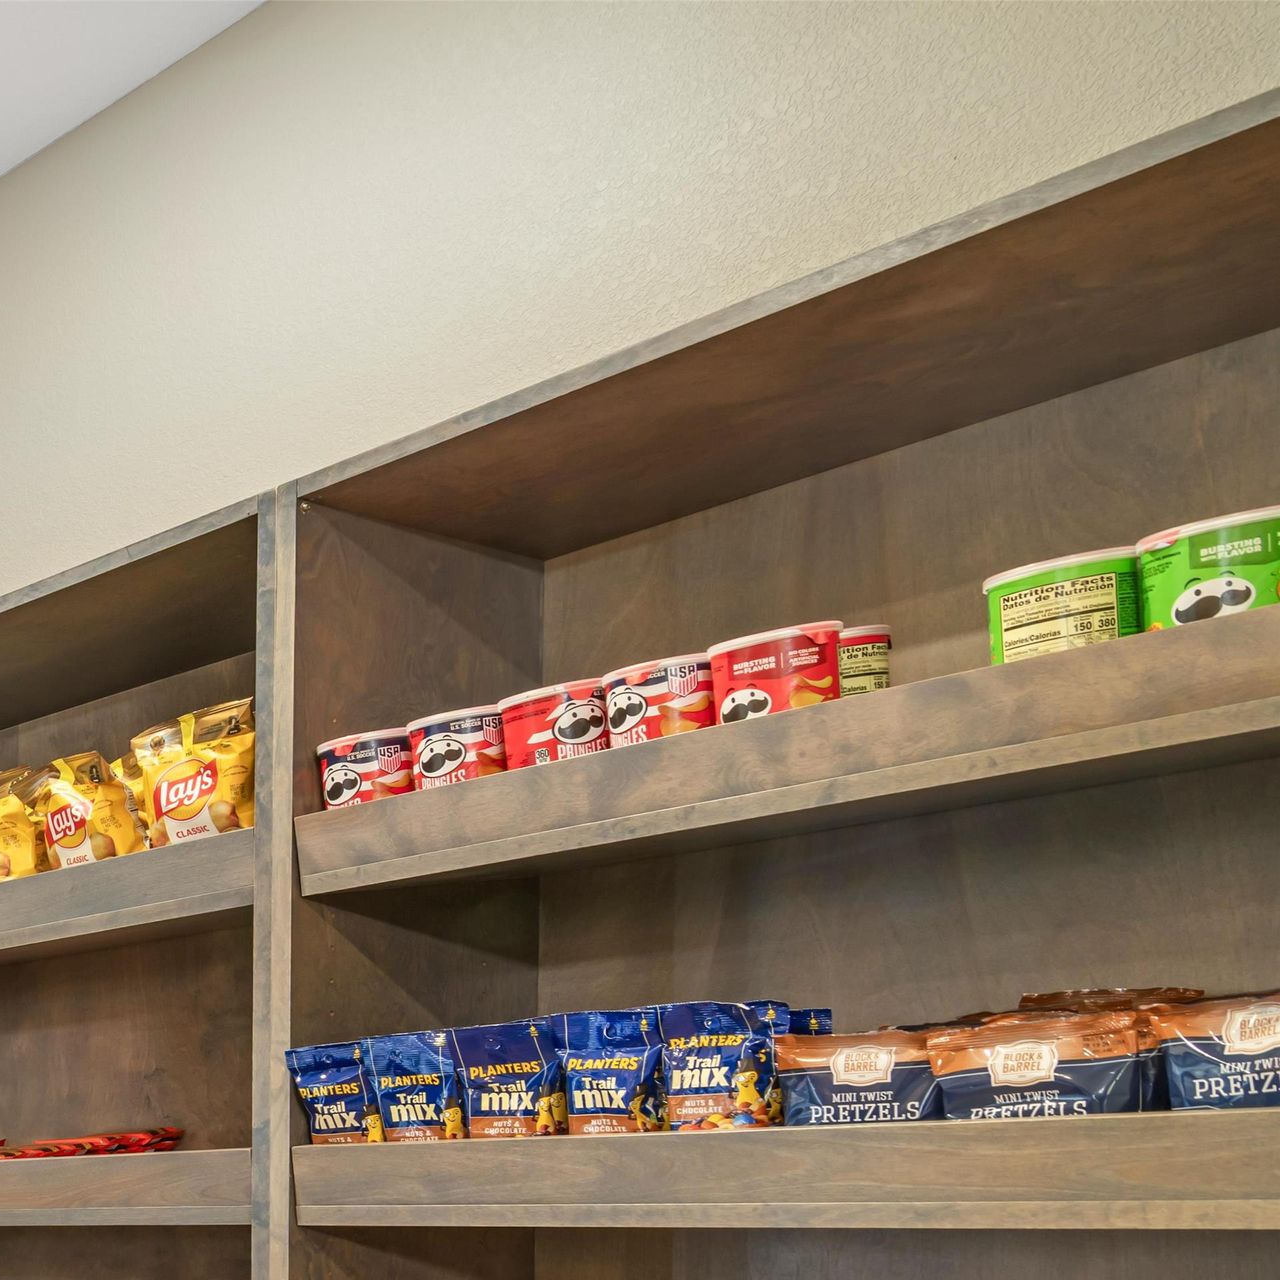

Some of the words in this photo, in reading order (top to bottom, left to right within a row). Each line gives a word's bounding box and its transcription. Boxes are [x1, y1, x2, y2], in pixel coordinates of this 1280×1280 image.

[1200, 537, 1261, 556] BURSTING
[1218, 545, 1262, 559] FLAVOR
[1002, 582, 1065, 604] Nutrition
[1071, 575, 1113, 587] Facts
[1003, 600, 1030, 611] Datos
[1035, 592, 1050, 602] de
[1055, 582, 1114, 598] Nutrición
[1074, 621, 1092, 633] 150
[1098, 618, 1116, 628] 380
[733, 656, 776, 671] BURSTING
[744, 663, 776, 674] FLAVOR
[669, 666, 696, 678] USA
[461, 719, 481, 729] SOCCER
[357, 751, 375, 760] SOCCER
[379, 746, 400, 757] USA
[536, 749, 549, 760] 360
[422, 769, 466, 790] PRINGLES
[160, 767, 213, 810] Lay's
[176, 824, 210, 839] CLASSIC
[66, 854, 89, 867] CLASSIC
[1240, 1026, 1277, 1041] BARREL
[669, 1034, 744, 1049] PLANTERS
[567, 1057, 637, 1072] PLANTERS
[686, 1055, 721, 1069] Trail
[845, 1053, 869, 1063] BLOCK
[1003, 1053, 1034, 1063] BLOCK
[470, 1061, 540, 1079] PLANTERS
[843, 1060, 879, 1072] BARREL
[1002, 1061, 1042, 1073] BARREL
[1220, 1061, 1251, 1075] MINI
[381, 1074, 440, 1089] PLANTERS
[582, 1077, 615, 1090] Trail
[671, 1067, 729, 1090] mix
[300, 1082, 359, 1099] PLANTERS
[489, 1081, 526, 1093] Trail
[396, 1094, 426, 1104] Trail
[481, 1092, 535, 1111] mix
[573, 1089, 627, 1109] mix
[832, 1093, 856, 1103] MINI
[858, 1091, 893, 1101] TWIST
[994, 1093, 1023, 1104] MINI
[1025, 1090, 1060, 1101] TWIST
[315, 1102, 345, 1114] Trail
[390, 1103, 438, 1122] mix
[676, 1106, 723, 1115] CHOCOLATE
[809, 1102, 920, 1123] PRETZELS
[314, 1112, 360, 1129] mix
[493, 1120, 511, 1128] NUTS
[591, 1119, 610, 1127] NUTS
[583, 1125, 627, 1133] CHOCOLATE
